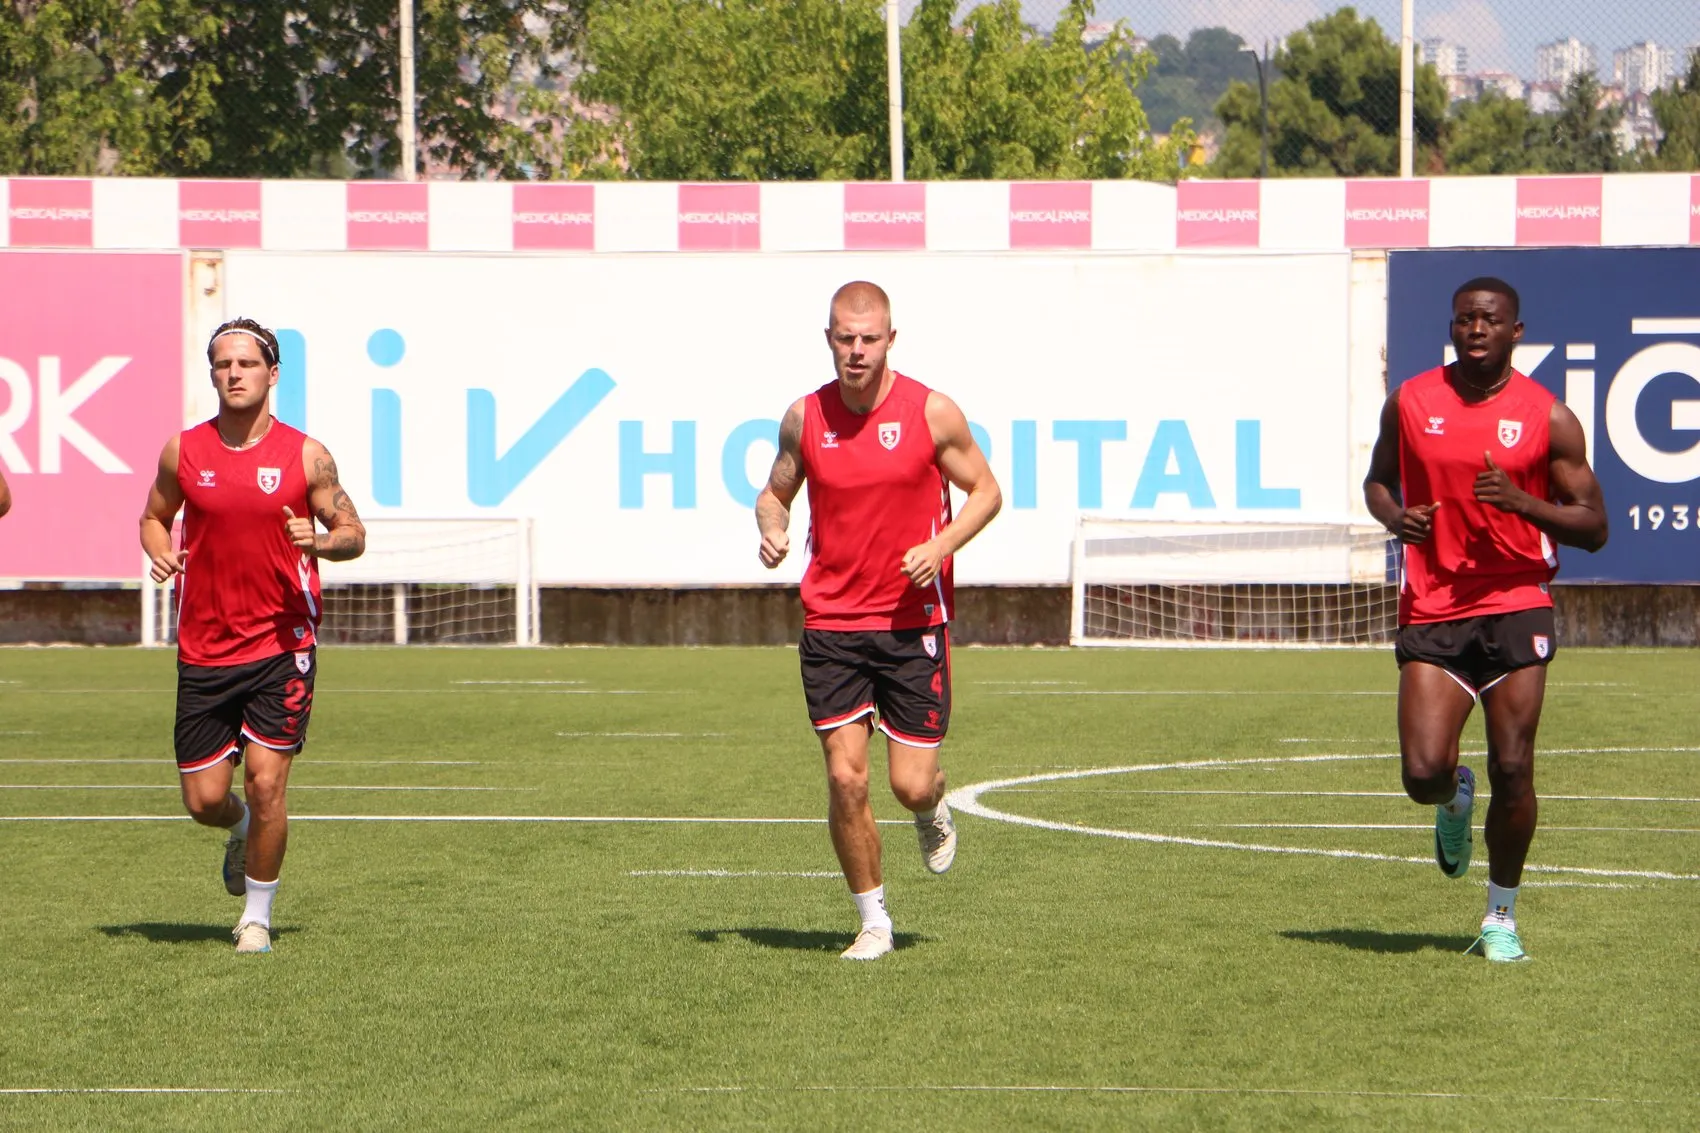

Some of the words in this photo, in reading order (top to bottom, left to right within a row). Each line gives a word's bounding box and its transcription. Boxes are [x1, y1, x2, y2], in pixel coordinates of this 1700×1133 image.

[1517, 205, 1600, 219] MEDICALPARK
[618, 419, 1301, 509] HOITAL
[1629, 505, 1700, 531] 193
